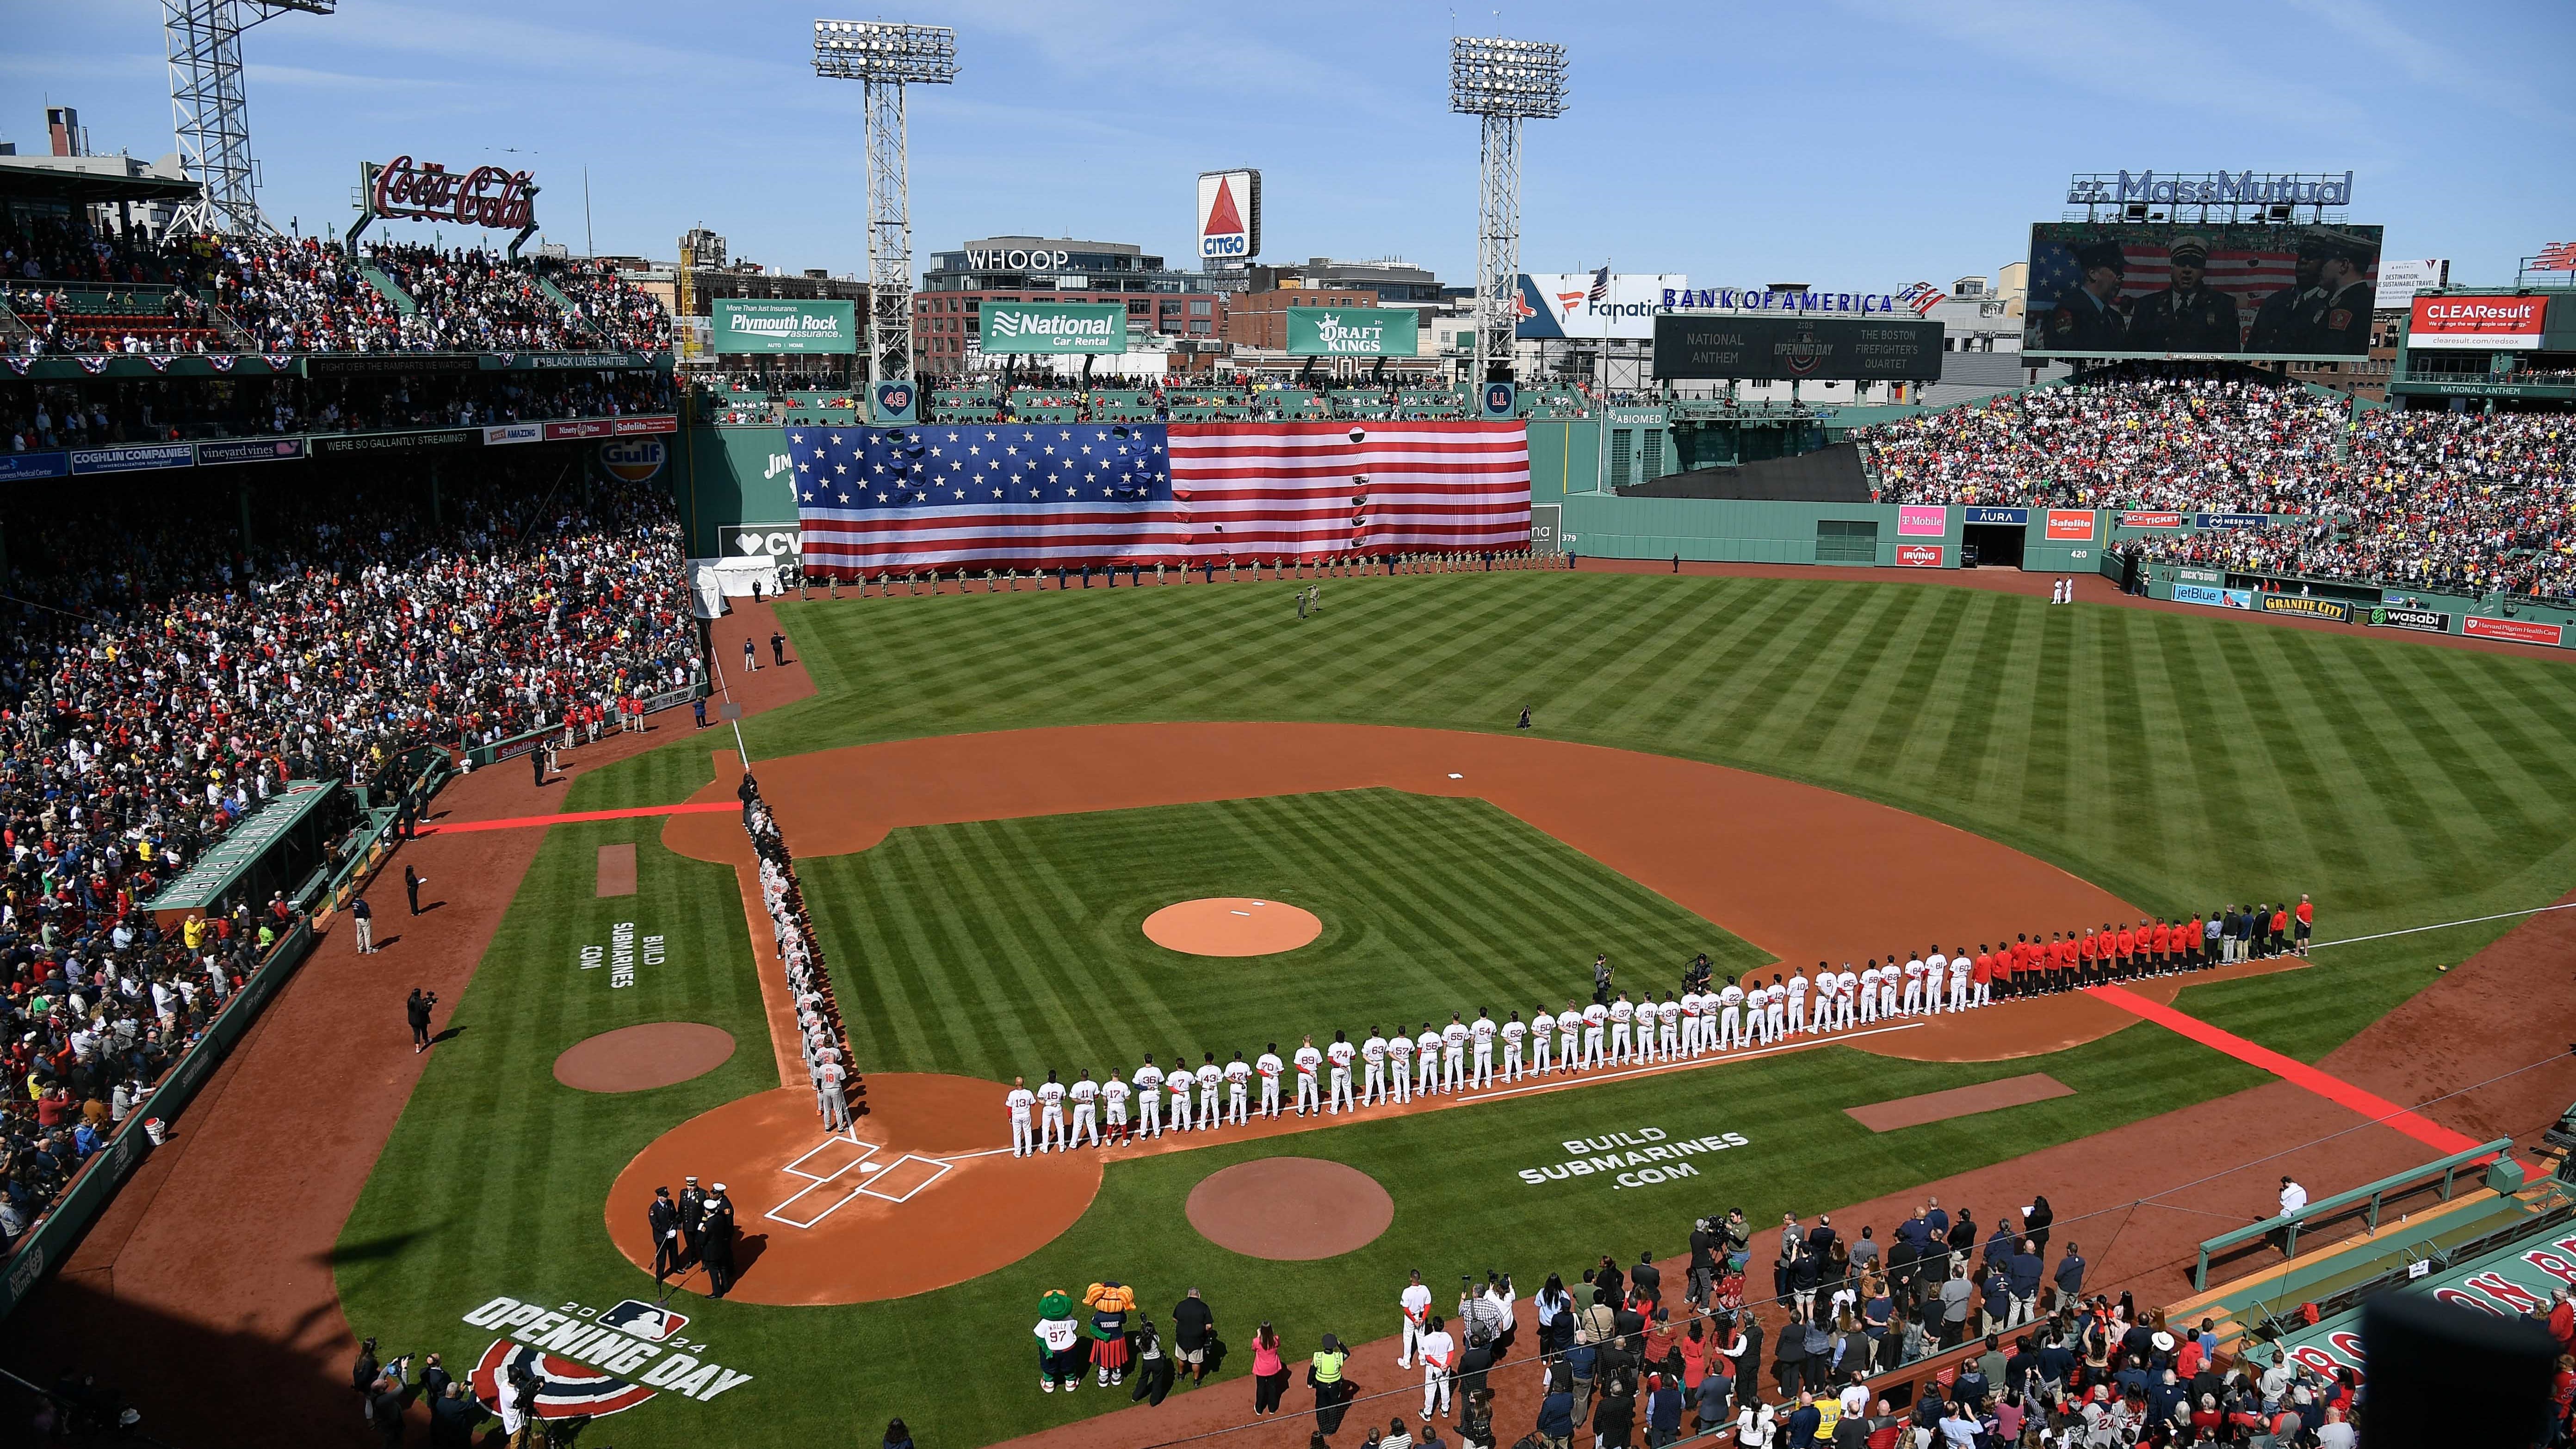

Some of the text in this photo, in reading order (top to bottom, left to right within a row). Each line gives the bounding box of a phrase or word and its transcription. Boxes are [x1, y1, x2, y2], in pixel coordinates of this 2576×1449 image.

[375, 155, 534, 229] Coca-Cola
[2117, 170, 2353, 204] MassMutual
[1204, 236, 1244, 254] CITGO
[966, 249, 1068, 270] WHOOP
[1663, 289, 1893, 312] BANK OF AMERICA
[2427, 304, 2531, 318] CLEAResult
[731, 315, 837, 330] Plymouth Rock
[1020, 315, 1113, 334] National
[1319, 326, 1383, 341] DRAFT
[1687, 334, 1744, 345] NATIONAL
[1861, 330, 1916, 341] THE BOSTON
[1053, 337, 1108, 346] Car Rental
[1328, 339, 1381, 352] KINGS
[1774, 343, 1833, 356] OPENING DAY
[1855, 344, 1918, 355] FIREFIGHTER'S
[546, 356, 628, 367] BLACK LIVES MATTER
[1691, 352, 1738, 363] ANTHEM
[1865, 359, 1907, 369] QUARTET
[321, 360, 473, 371] FIGHT O'ER THE RAMPARTS WE WATCHED
[884, 392, 906, 407] 49
[1492, 392, 1506, 406] LL
[1616, 414, 1661, 424] ABIOMED
[508, 430, 535, 438] AMAZING
[617, 422, 647, 432] Safelite
[326, 433, 466, 452] WERE SO GALLANTLY STREAMING?
[74, 447, 191, 464] COGHLIN COMPANIES
[202, 446, 273, 460] vineyard vines
[603, 444, 660, 462] Gulf
[764, 453, 793, 480] JIM
[1911, 516, 1942, 526] Mobile
[2050, 519, 2090, 527] Safelite
[2146, 515, 2179, 524] TICKET
[1903, 551, 1935, 560] IRVING
[2071, 550, 2087, 558] 420
[2181, 570, 2204, 581] DICK'S
[2177, 587, 2216, 603] jetBlue
[2266, 598, 2344, 617] GRANITE CITY
[2387, 610, 2439, 625] wasabi
[2502, 624, 2523, 633] Pilgrim
[580, 945, 603, 969] .COM
[611, 923, 634, 988] SUBMARINES
[643, 935, 665, 965] BUILD
[1372, 1046, 1384, 1054] 63
[1109, 1090, 1121, 1098] 17
[1016, 1099, 1026, 1107] 13
[1562, 1127, 1667, 1154] BUILD
[1518, 1132, 1748, 1184] SUBMARINES
[1612, 1162, 1700, 1190] .COM
[9, 1260, 29, 1285] Ninety
[11, 1273, 31, 1303] Nine
[559, 1301, 706, 1353] 20 24
[1050, 1331, 1066, 1342] 97
[462, 1296, 753, 1401] OPENING DAY
[2098, 1417, 2114, 1430] 24
